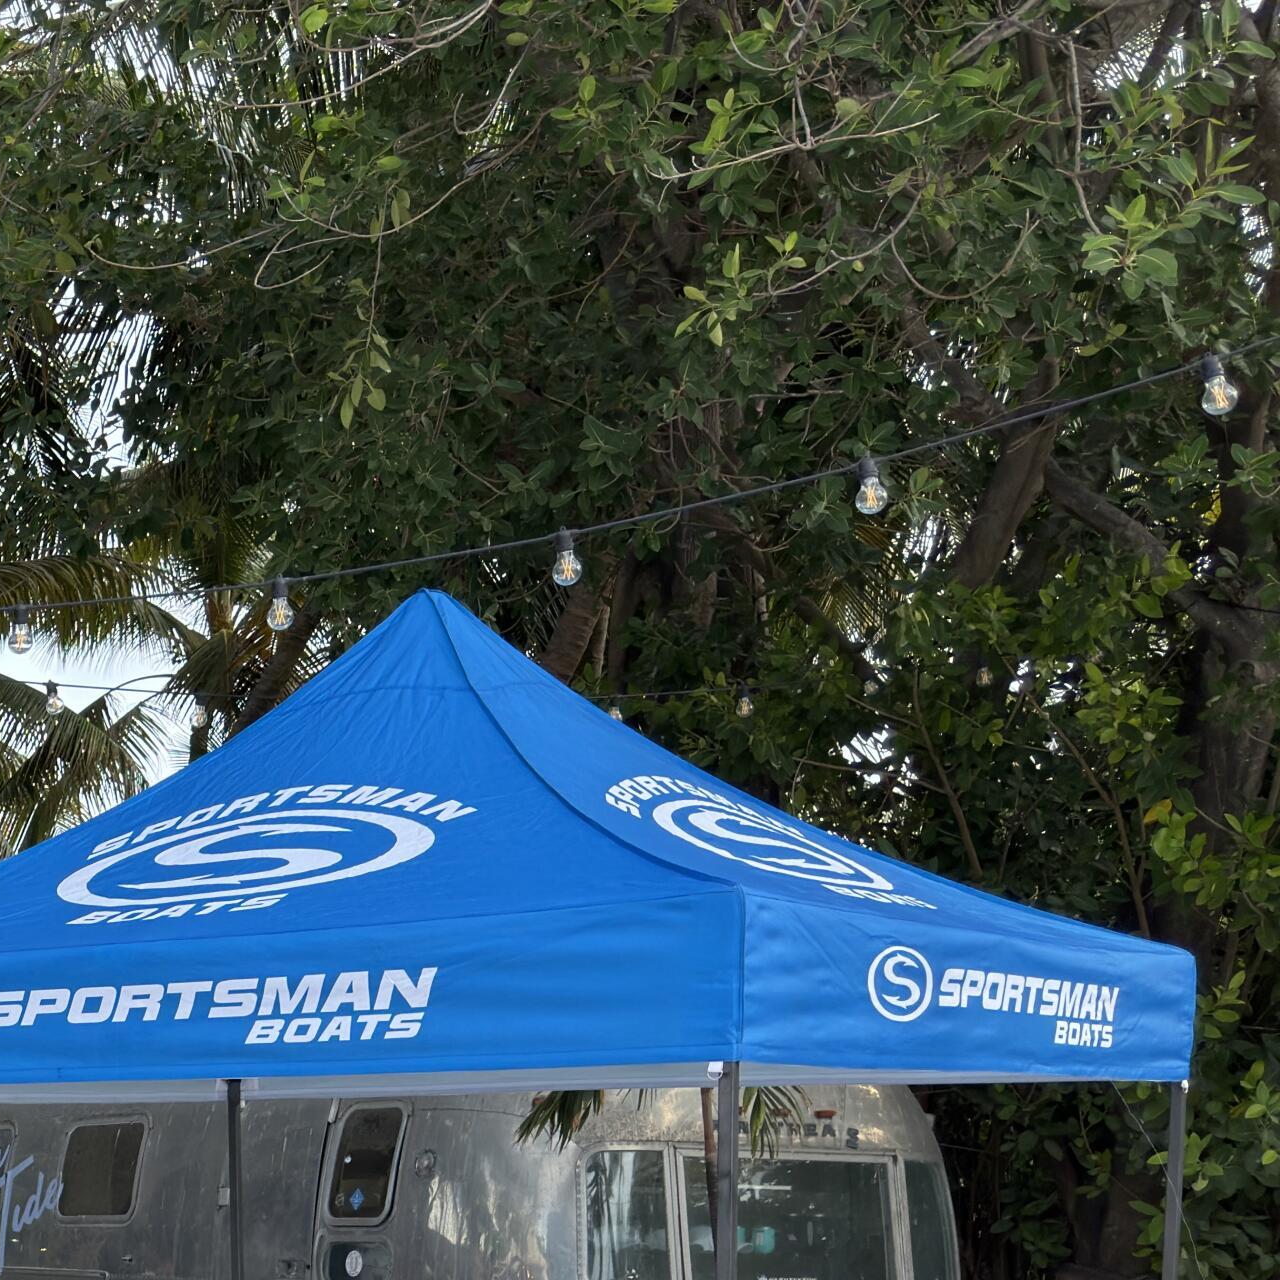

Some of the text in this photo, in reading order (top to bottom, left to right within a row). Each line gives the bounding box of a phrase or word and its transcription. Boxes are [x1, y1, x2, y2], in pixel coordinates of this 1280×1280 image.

[87, 783, 478, 861] SPORTSMAN
[65, 893, 289, 926] BOATS
[938, 968, 1120, 1022] SPORTSMAN
[245, 1011, 425, 1045] BOATS
[1054, 1020, 1113, 1048] BOATS
